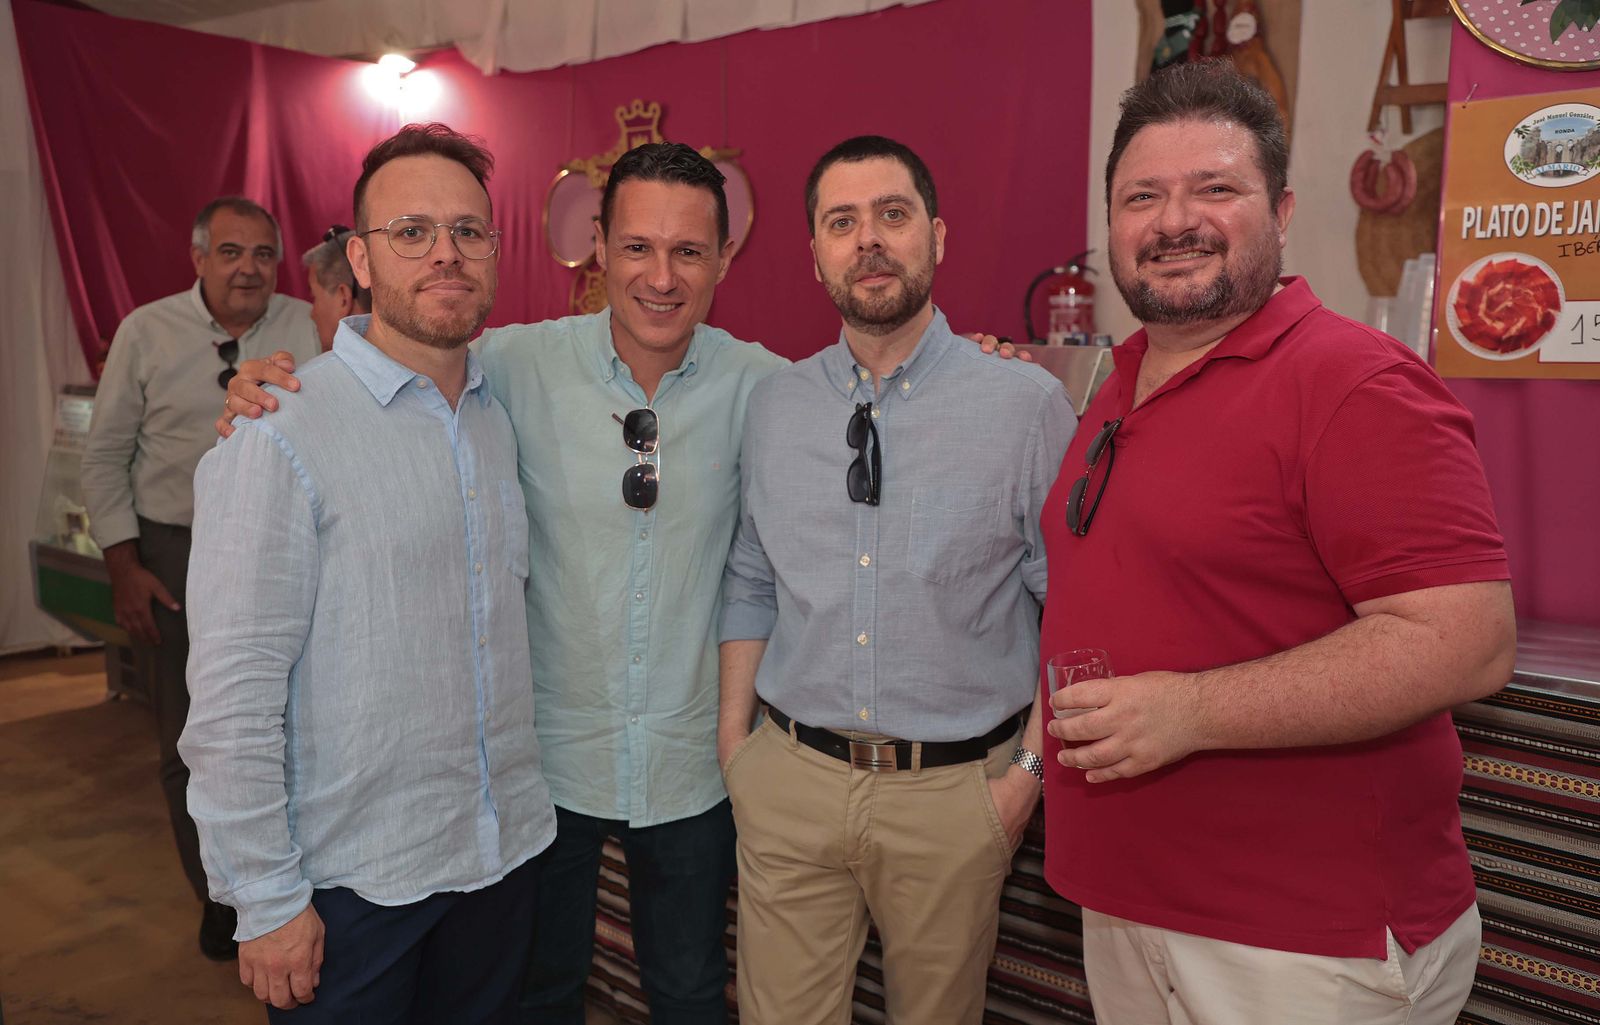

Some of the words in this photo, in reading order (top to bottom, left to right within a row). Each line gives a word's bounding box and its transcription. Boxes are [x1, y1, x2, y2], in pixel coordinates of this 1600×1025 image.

[1532, 116, 1545, 125] José
[1547, 112, 1568, 120] Manuel
[1462, 203, 1529, 239] PLATO
[1533, 201, 1565, 236] DE
